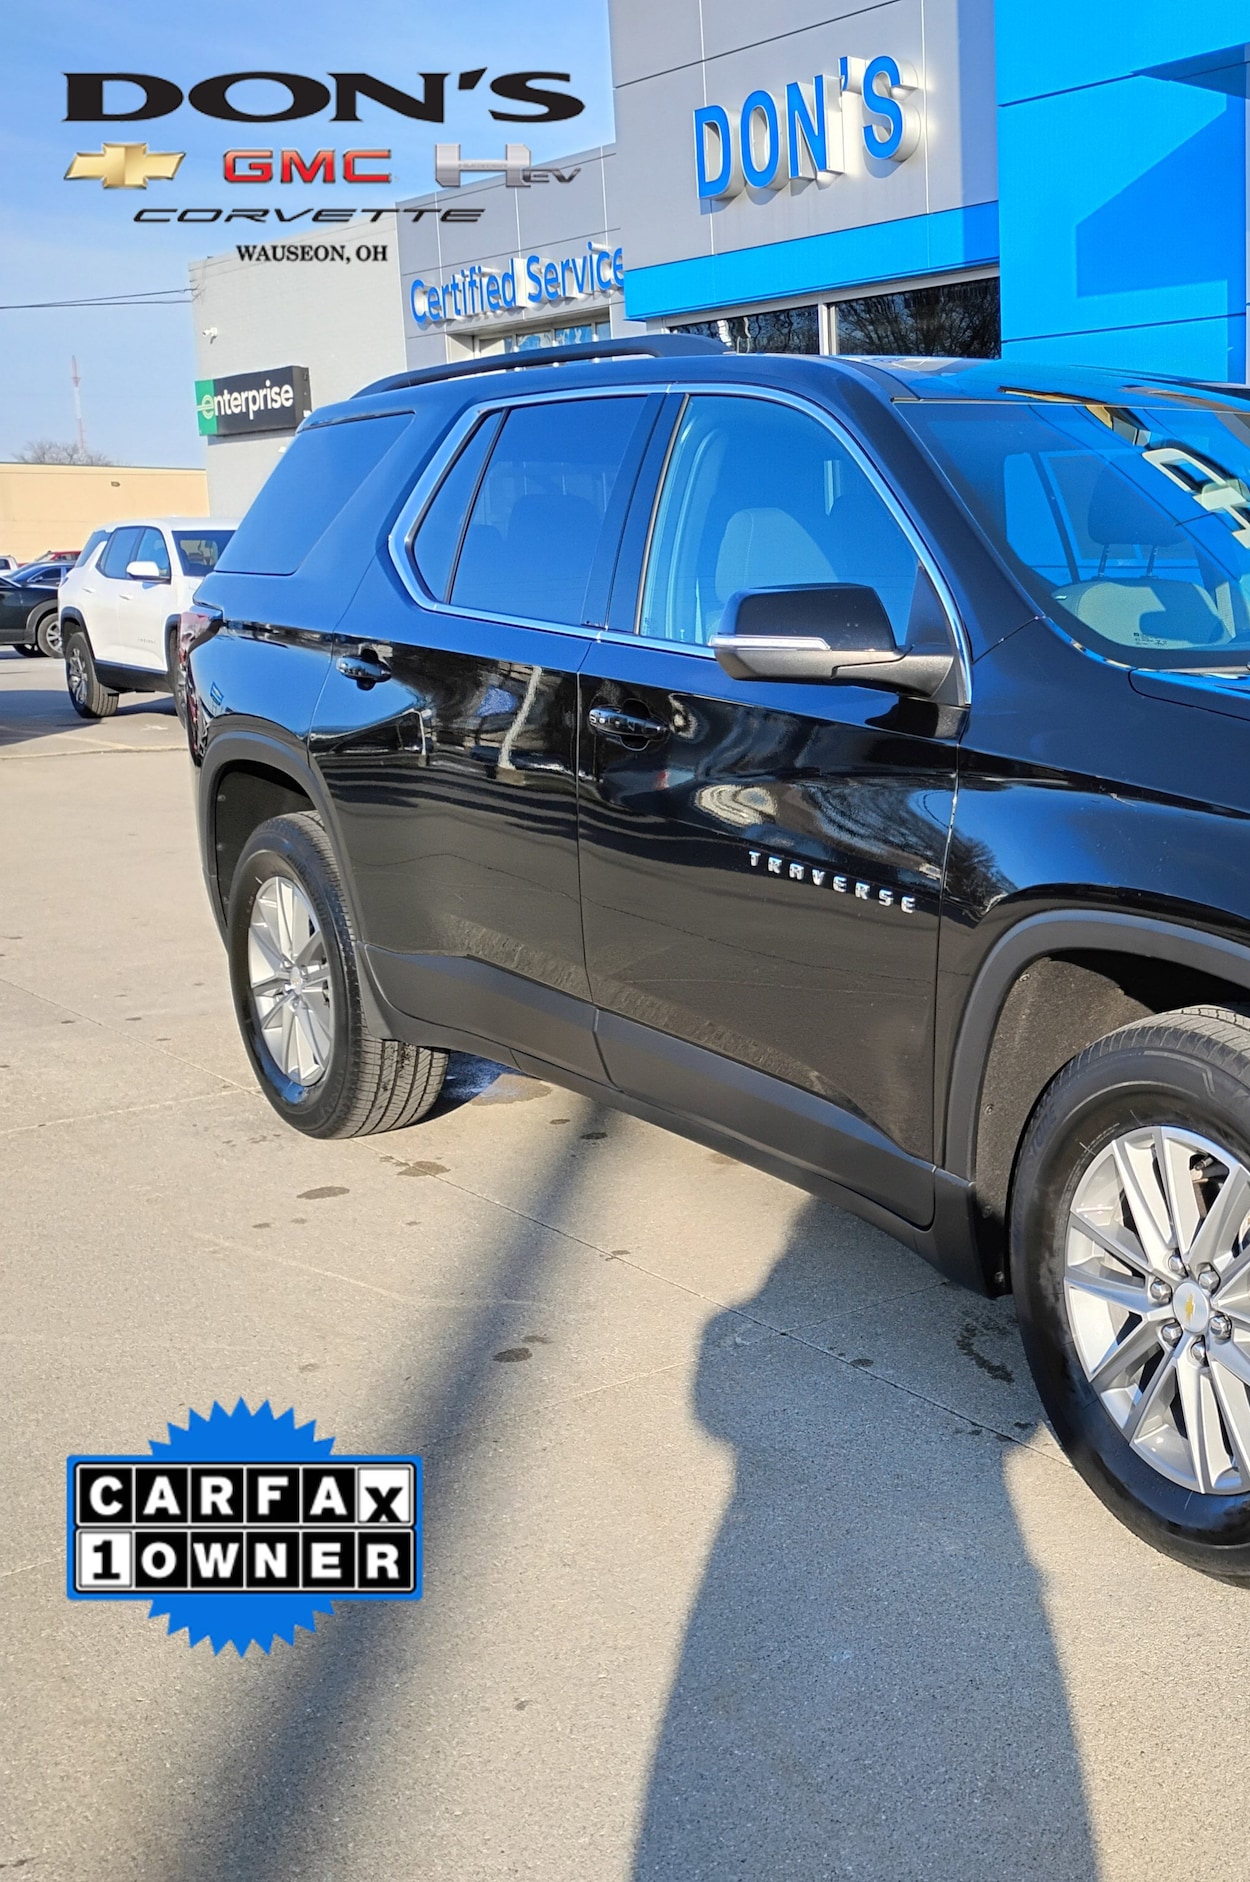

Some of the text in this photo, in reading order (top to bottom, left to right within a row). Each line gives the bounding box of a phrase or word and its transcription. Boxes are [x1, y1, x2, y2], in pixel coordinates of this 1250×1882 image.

[694, 55, 905, 199] DON'S
[410, 241, 624, 324] Certified Service
[197, 379, 294, 420] enterprise
[749, 850, 916, 914] TRAVERSE
